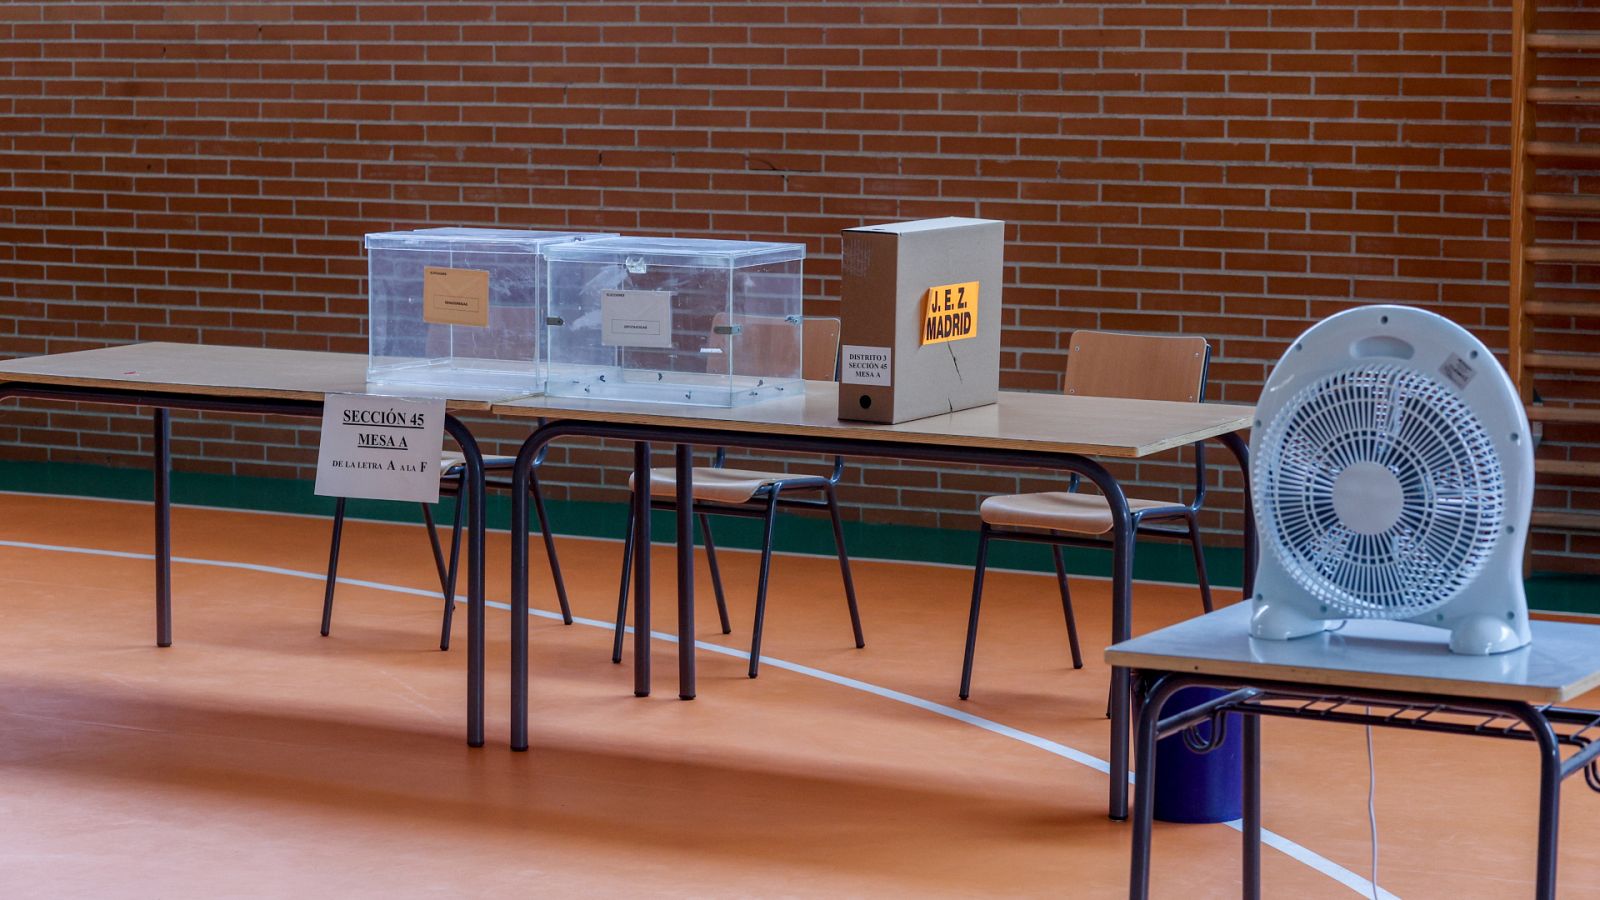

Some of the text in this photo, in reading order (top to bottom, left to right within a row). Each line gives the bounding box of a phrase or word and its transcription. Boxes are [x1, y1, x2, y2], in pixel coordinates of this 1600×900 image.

[932, 287, 967, 313] J. E. Z.
[926, 312, 971, 340] MADRID
[849, 353, 882, 361] DISTRITO
[848, 361, 879, 369] SECCIÓN
[343, 408, 424, 426] SECCIÓN 45
[358, 433, 408, 448] MESA A
[357, 462, 382, 470] LETRA
[387, 460, 395, 471] A
[420, 461, 427, 472] F
